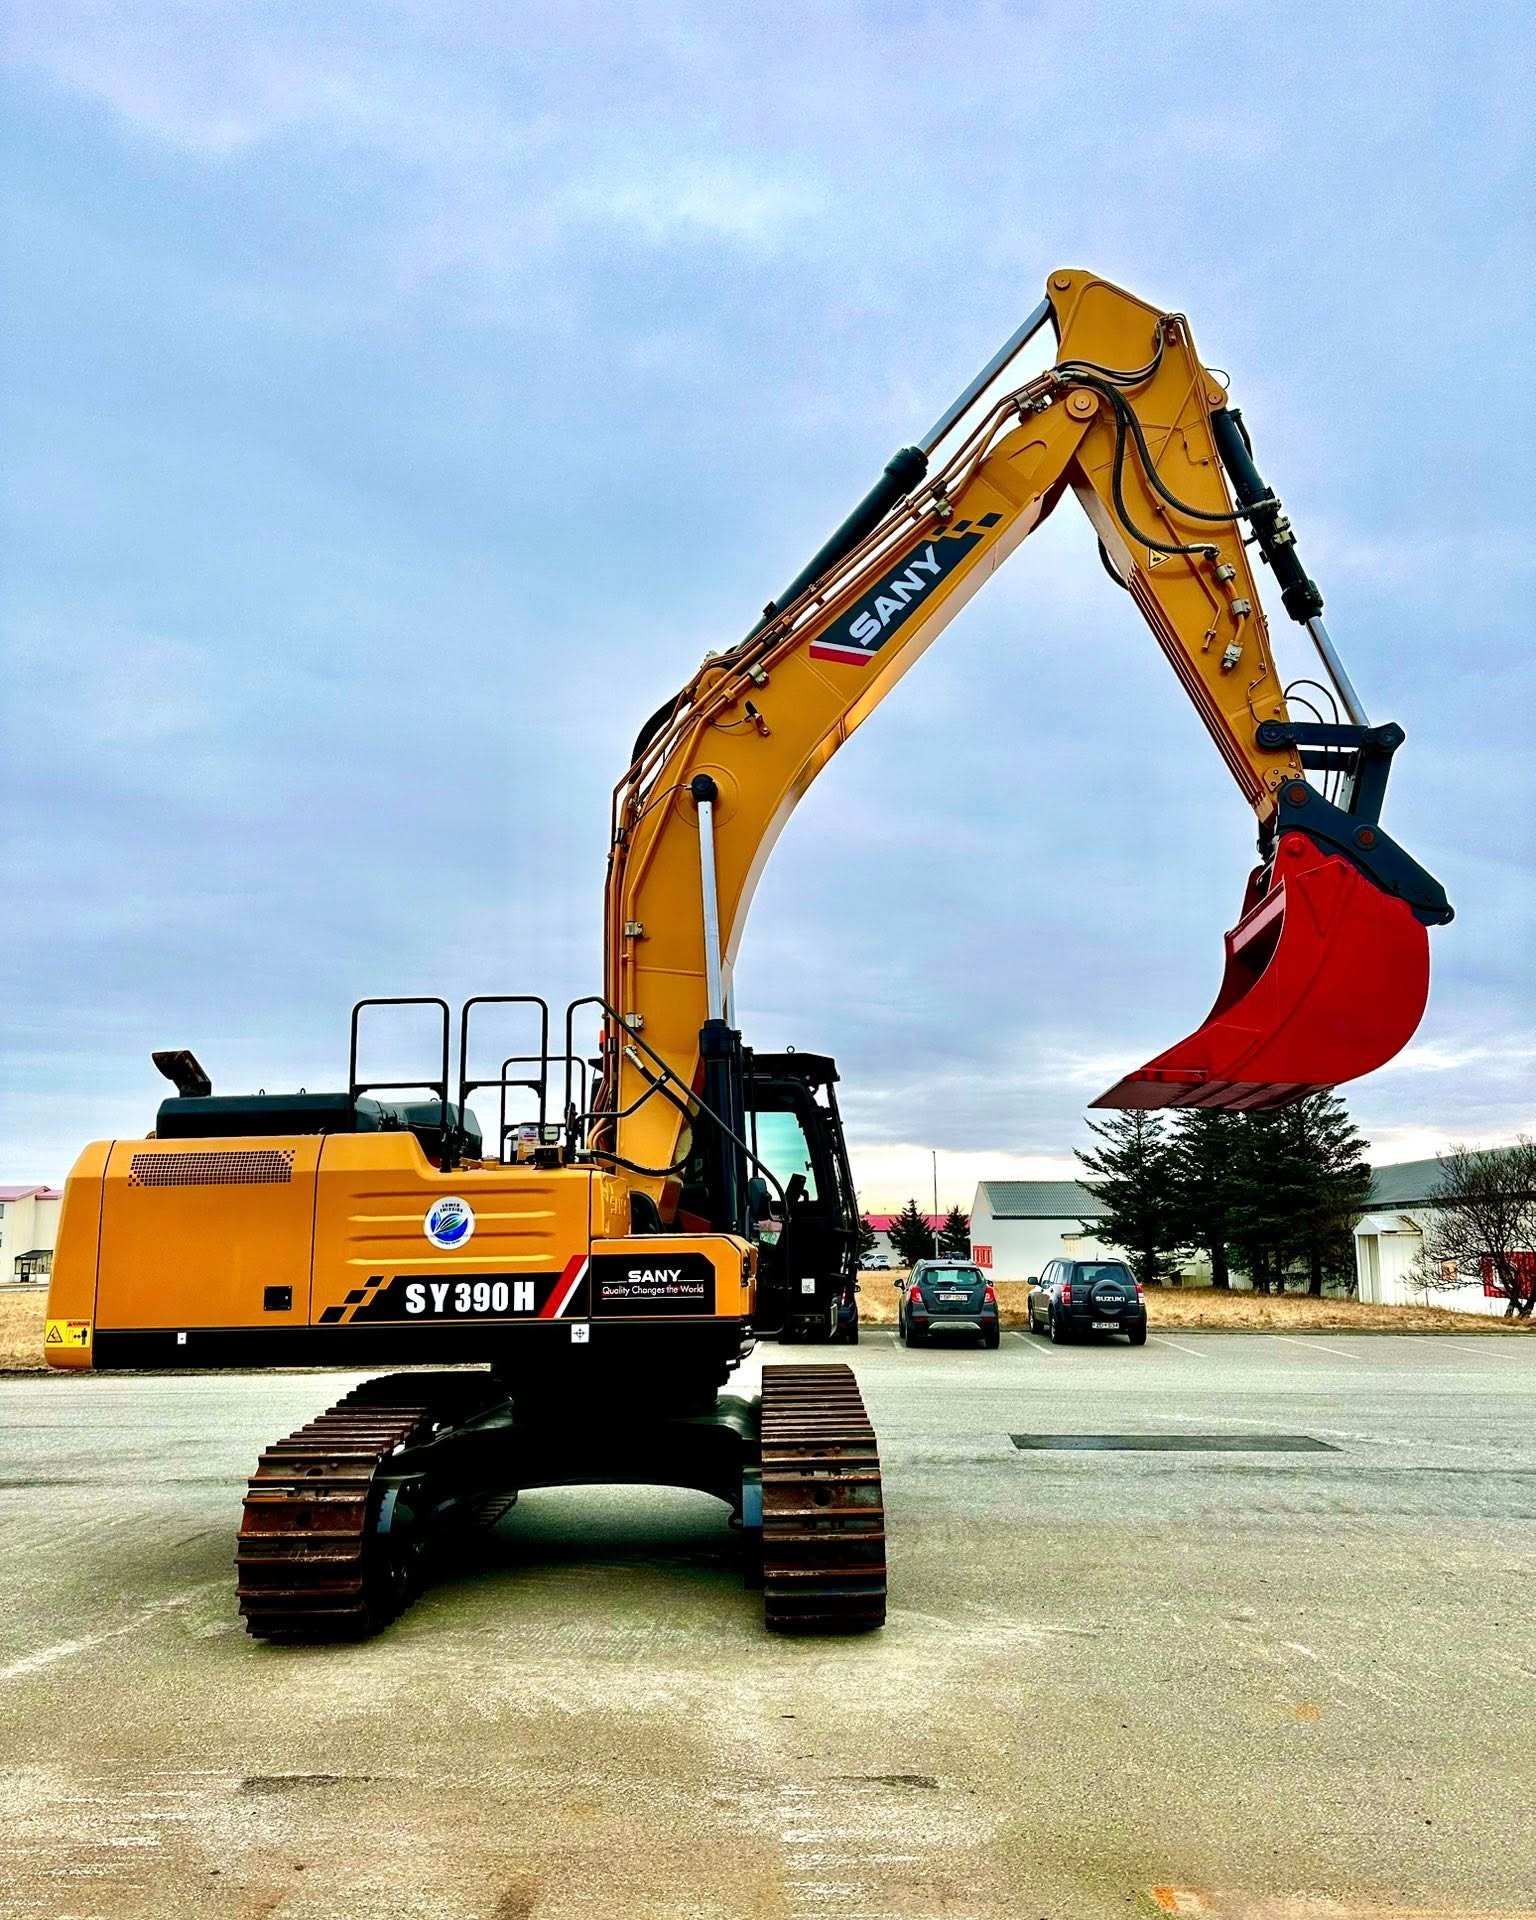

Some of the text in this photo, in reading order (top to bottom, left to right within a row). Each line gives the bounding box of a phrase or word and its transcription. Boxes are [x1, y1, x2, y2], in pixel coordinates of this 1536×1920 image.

[849, 544, 942, 647] SANY
[627, 1269, 682, 1283] SANY
[602, 1283, 704, 1297] Quality Changes the World
